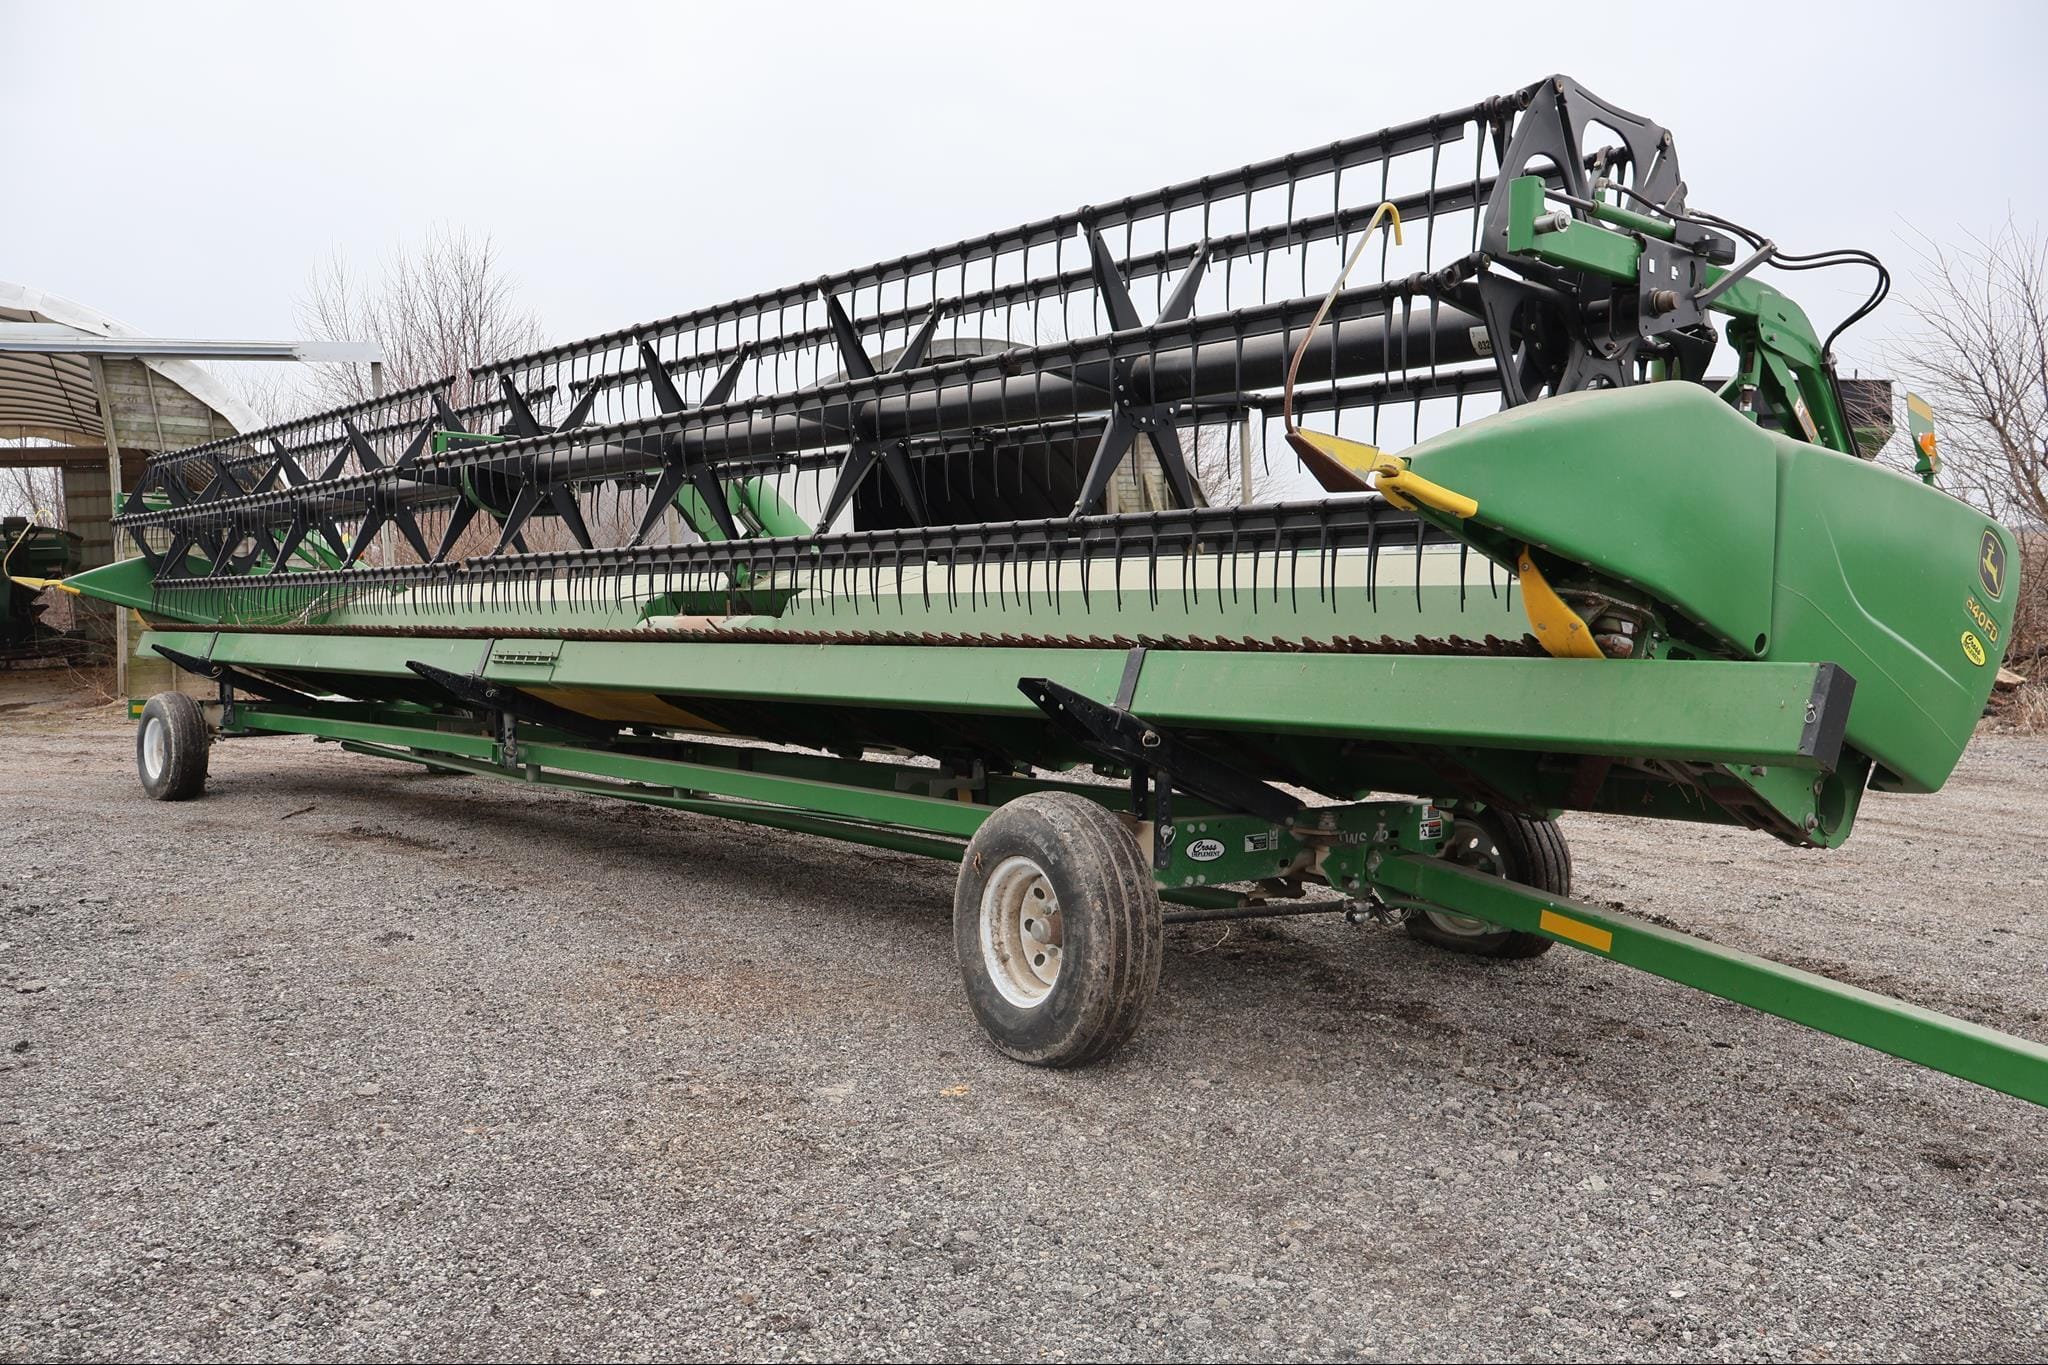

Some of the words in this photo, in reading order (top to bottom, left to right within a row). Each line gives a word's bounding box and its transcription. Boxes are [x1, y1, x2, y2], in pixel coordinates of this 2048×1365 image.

[1966, 596, 1998, 642] 640FD
[1193, 840, 1217, 853] Cross
[1191, 850, 1220, 858] IMPLEMENT
